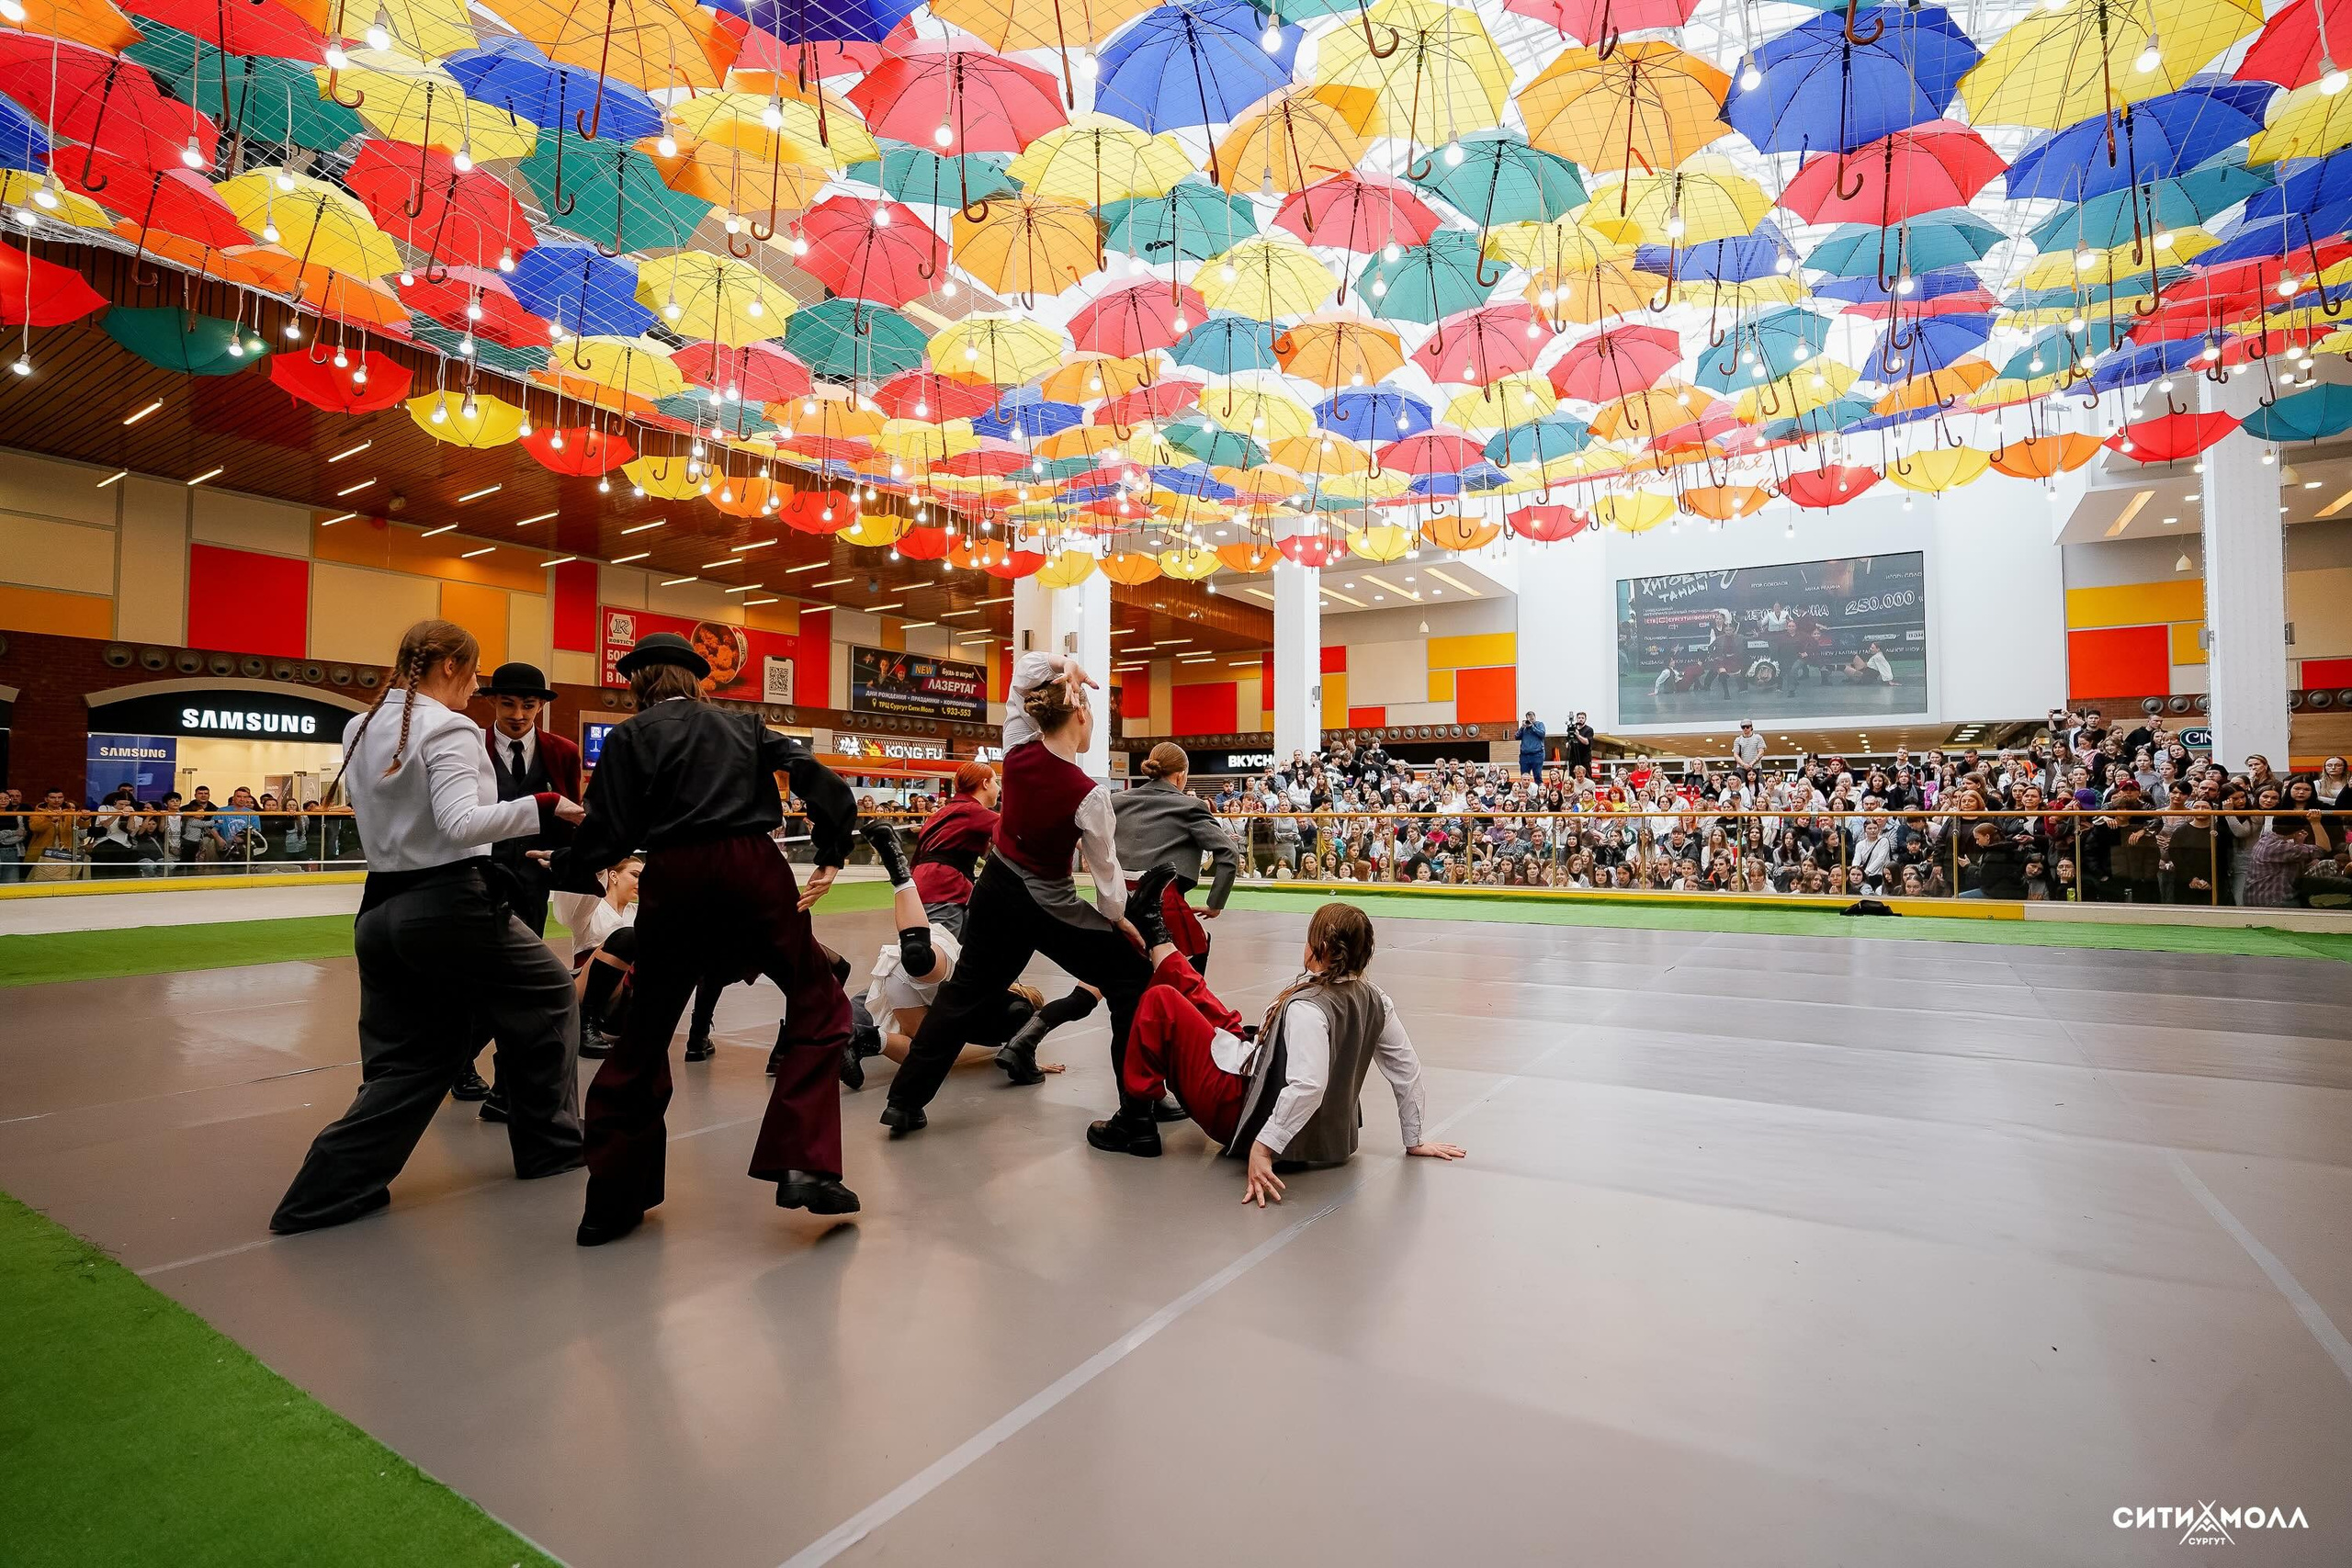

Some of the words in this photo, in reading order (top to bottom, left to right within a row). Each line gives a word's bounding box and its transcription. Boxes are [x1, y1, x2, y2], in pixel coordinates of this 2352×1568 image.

[1657, 579, 1708, 604] ТАНЦЫ
[1845, 590, 1916, 615] 250.000
[606, 649, 630, 661] БОЛ
[915, 665, 933, 675] NEW
[942, 667, 955, 676] Будь
[959, 671, 975, 679] игре!
[928, 679, 977, 694] ЛАЗЕРТАГ
[878, 692, 907, 701] РОЖДЕНИЯ
[910, 695, 940, 705] ПРАЗДНИКИ
[943, 699, 978, 708] КОРПОРАТИВЫ
[878, 701, 890, 709] ТРЦ
[890, 703, 908, 712] Сургут
[946, 707, 972, 716] 933-553
[182, 708, 316, 734] SAMSUNG
[99, 746, 166, 759] SAMSUNG
[885, 746, 924, 760] KONG
[926, 747, 944, 761] FU
[1227, 754, 1274, 768] ВКУСН
